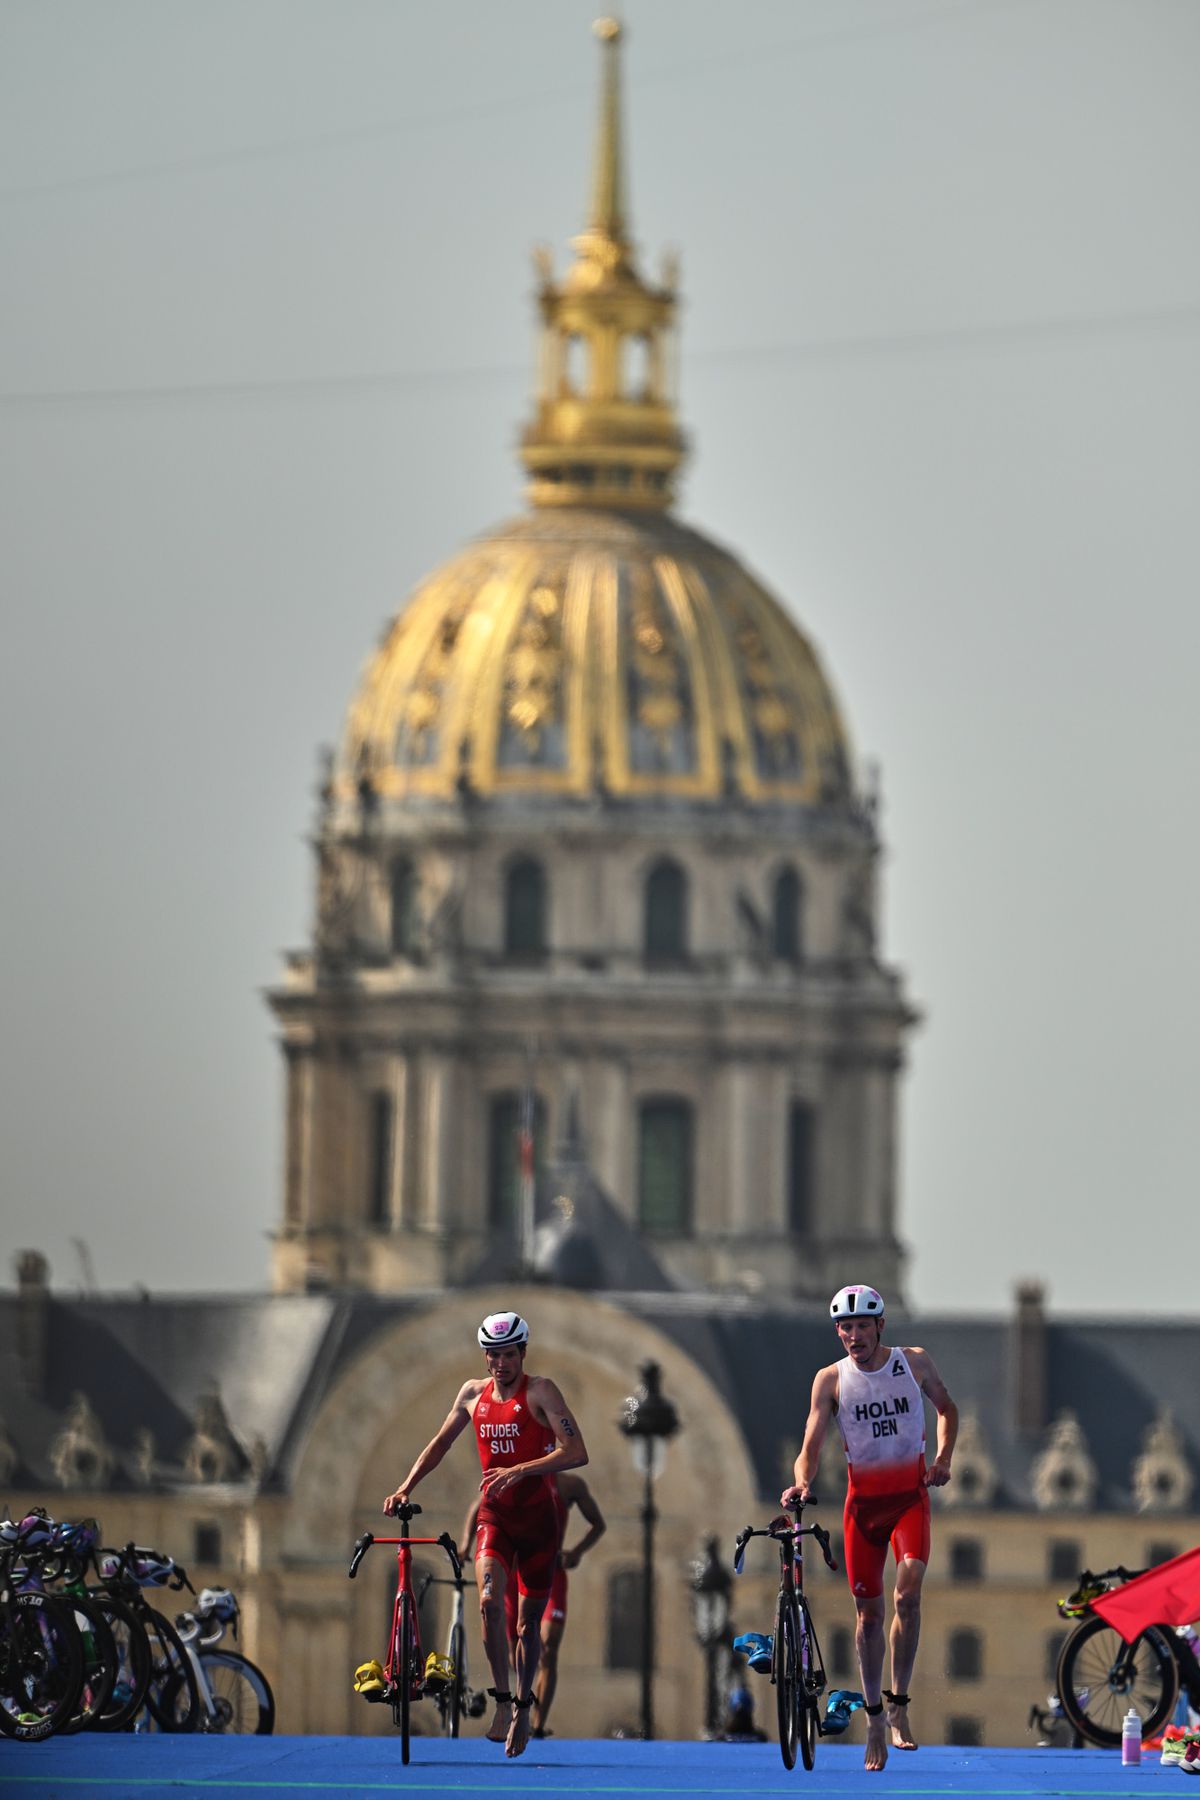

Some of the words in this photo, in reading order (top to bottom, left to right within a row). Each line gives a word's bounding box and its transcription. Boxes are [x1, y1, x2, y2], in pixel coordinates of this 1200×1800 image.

[855, 1397, 909, 1421] HOLM
[479, 1423, 520, 1437] STUDER
[872, 1419, 898, 1438] DEN
[490, 1440, 515, 1454] SUI
[15, 1726, 29, 1736] DT
